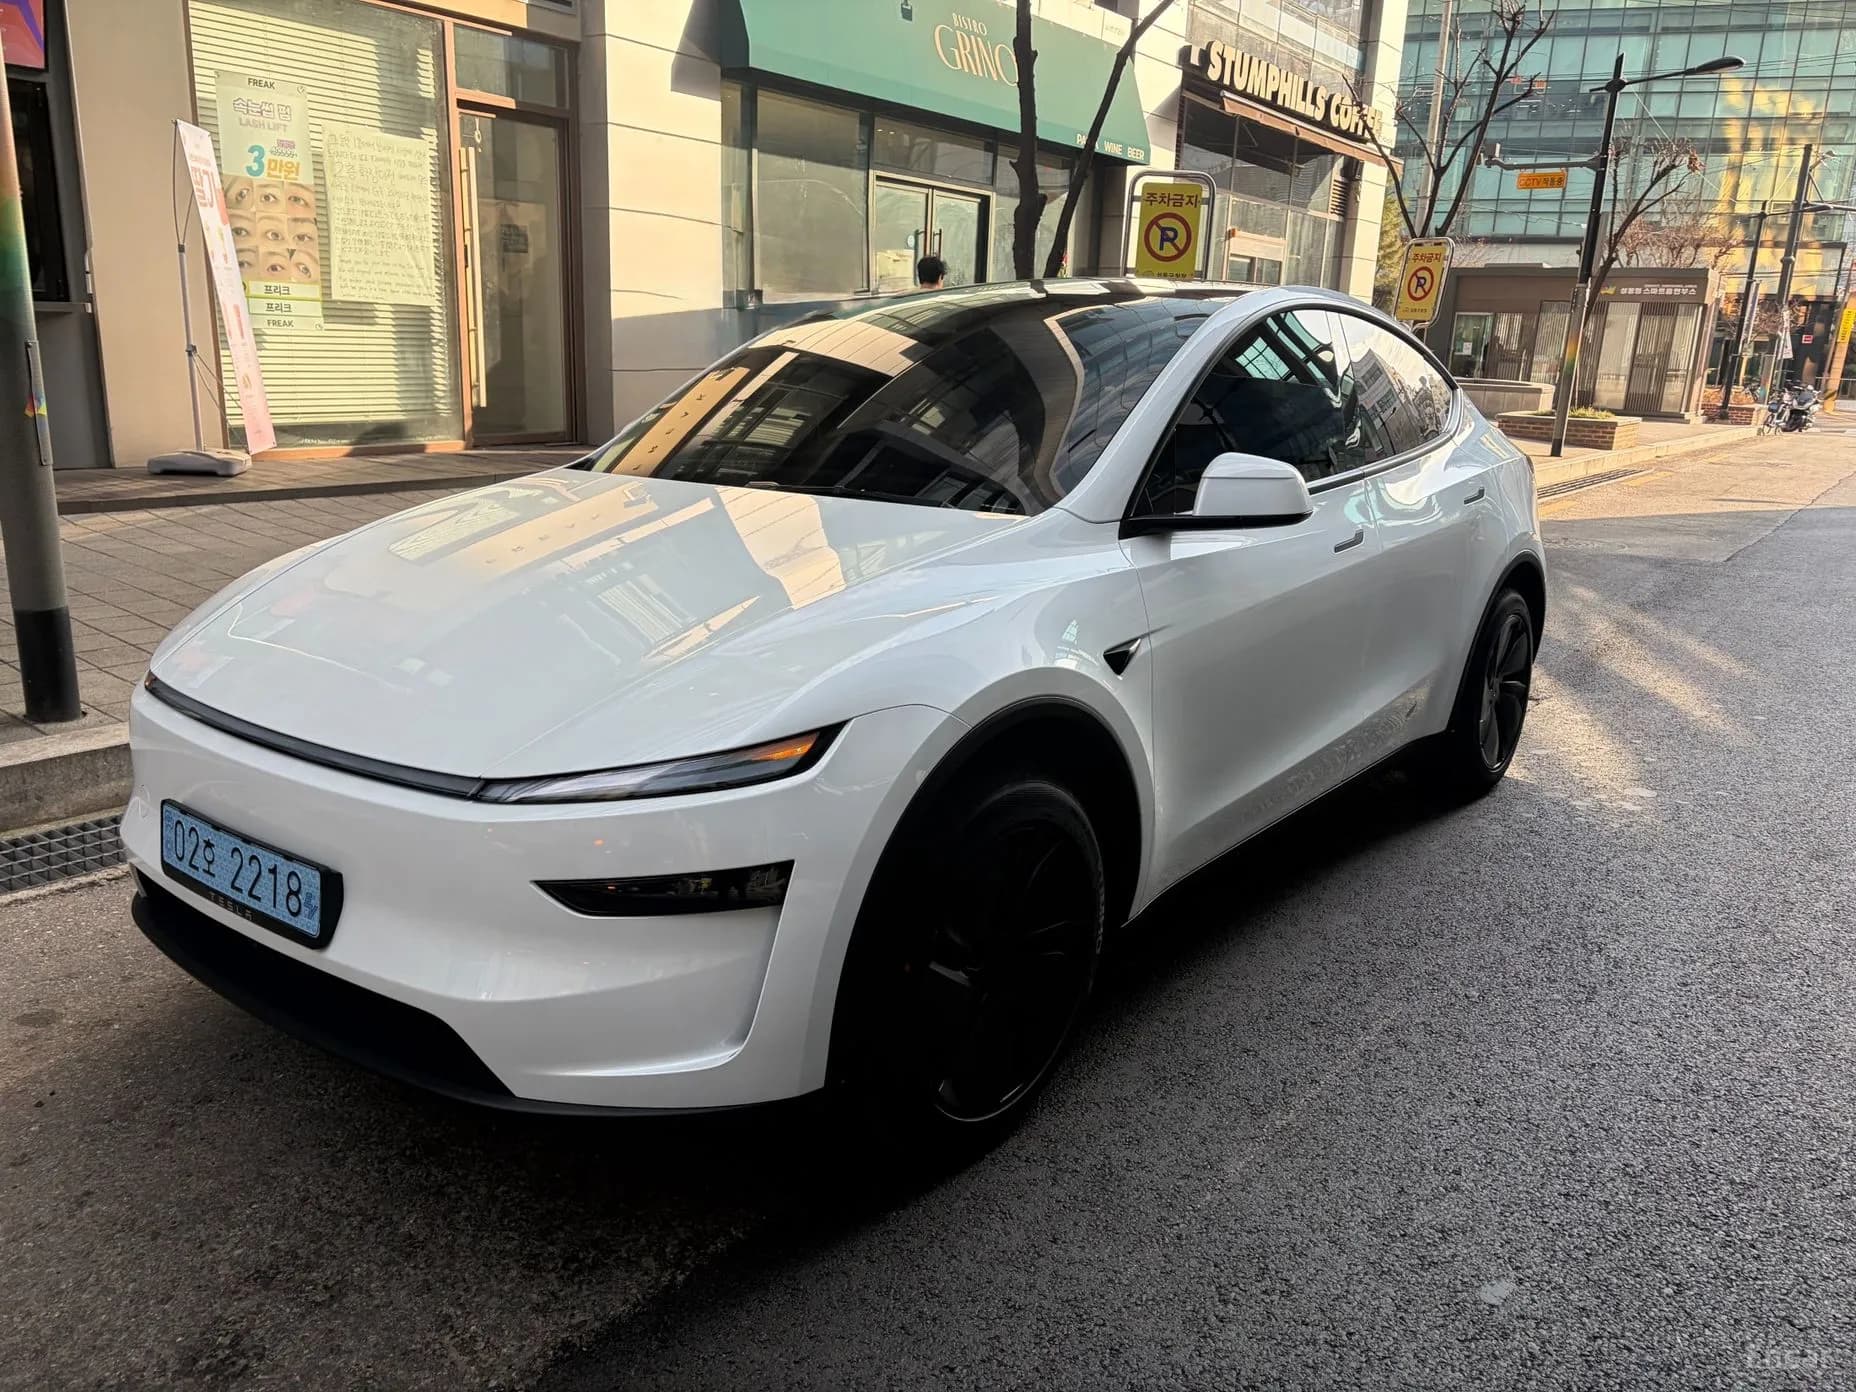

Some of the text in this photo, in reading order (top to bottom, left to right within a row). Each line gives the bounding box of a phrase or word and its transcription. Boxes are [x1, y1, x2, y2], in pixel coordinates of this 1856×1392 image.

[952, 12, 987, 36] BISTRO
[934, 24, 1019, 87] GRINO
[247, 77, 275, 89] FREAK
[1207, 39, 1327, 121] STUMPHILLS
[233, 97, 275, 119] 속눈썹
[1104, 140, 1123, 155] WINE
[1127, 146, 1145, 160] BEER
[1145, 192, 1199, 208] 주차금지
[1411, 252, 1442, 263] 주차금지
[264, 284, 291, 296] 프리크
[265, 302, 292, 313] 프리크
[266, 319, 294, 328] FREAK
[174, 819, 216, 878] 02호
[230, 846, 303, 918] 2218
